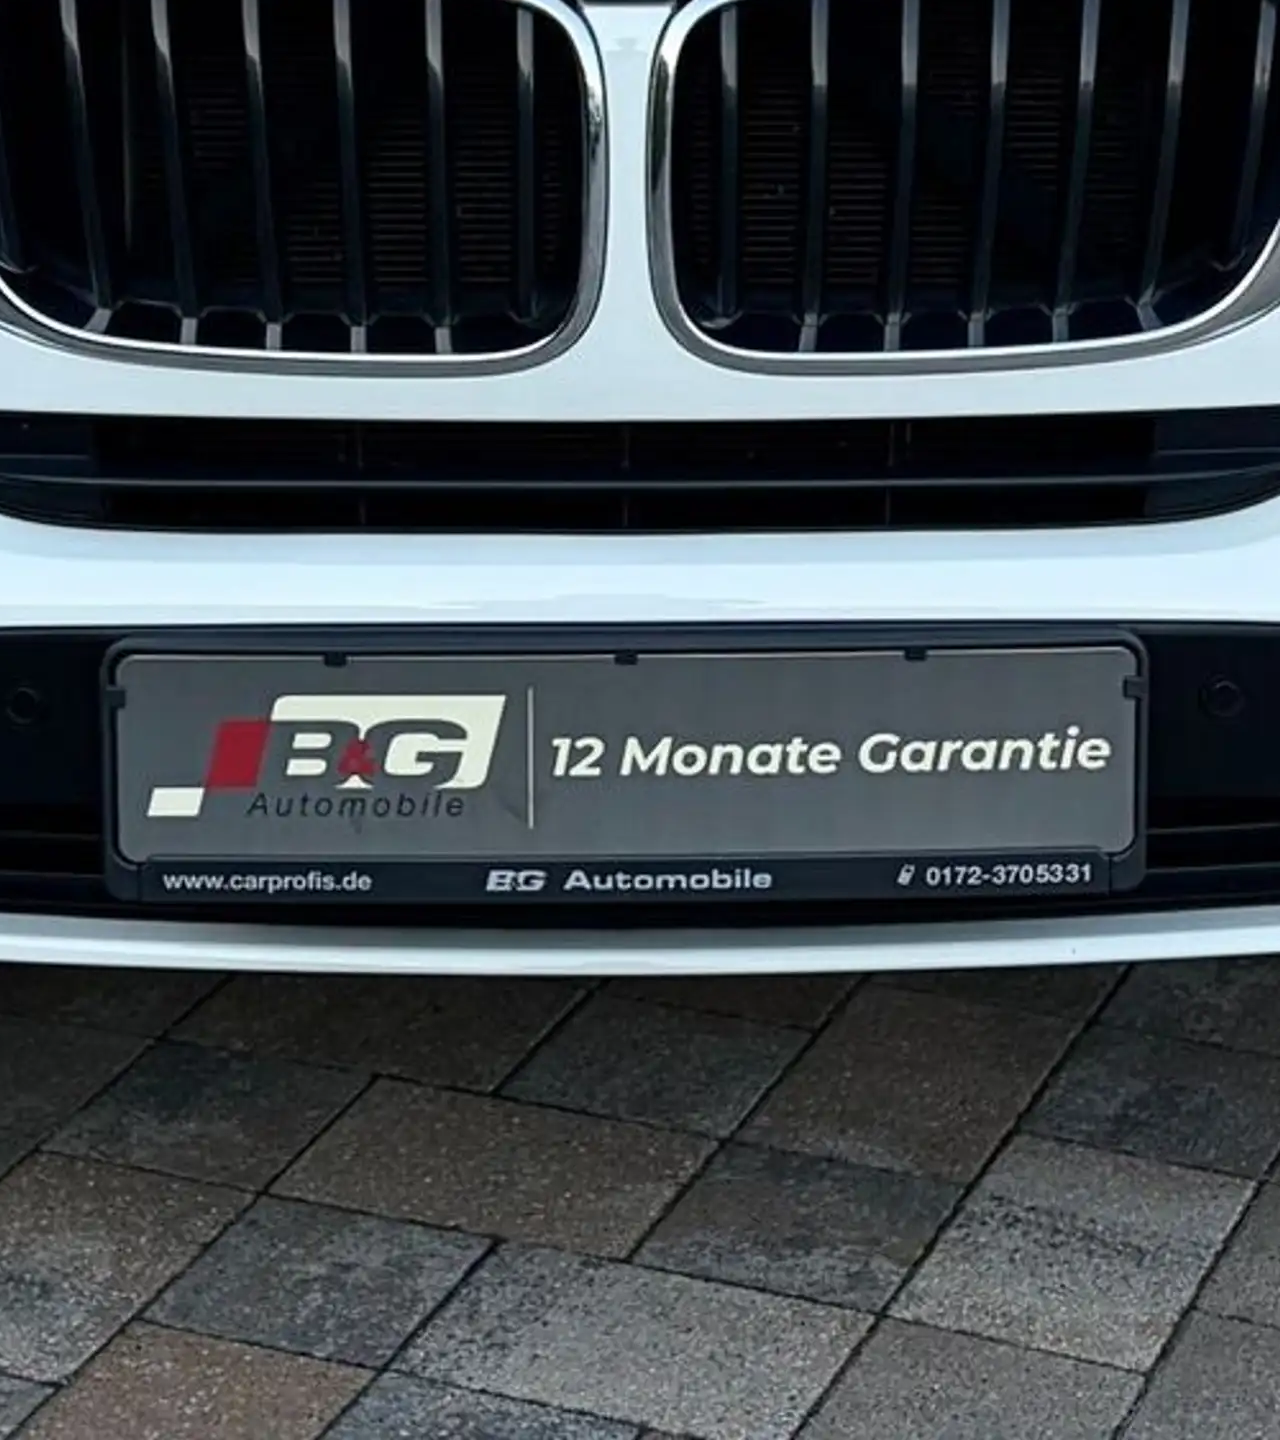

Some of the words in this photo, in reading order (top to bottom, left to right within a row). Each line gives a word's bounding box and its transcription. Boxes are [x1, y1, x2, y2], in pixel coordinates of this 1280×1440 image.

[551, 736, 606, 777] 12
[619, 735, 843, 777] Monate
[857, 724, 1112, 774] Garantie
[245, 791, 466, 818] Automobile
[162, 870, 373, 895] www.carprofis.de
[562, 867, 773, 891] Automobile
[925, 863, 1092, 887] 0172-3705331
